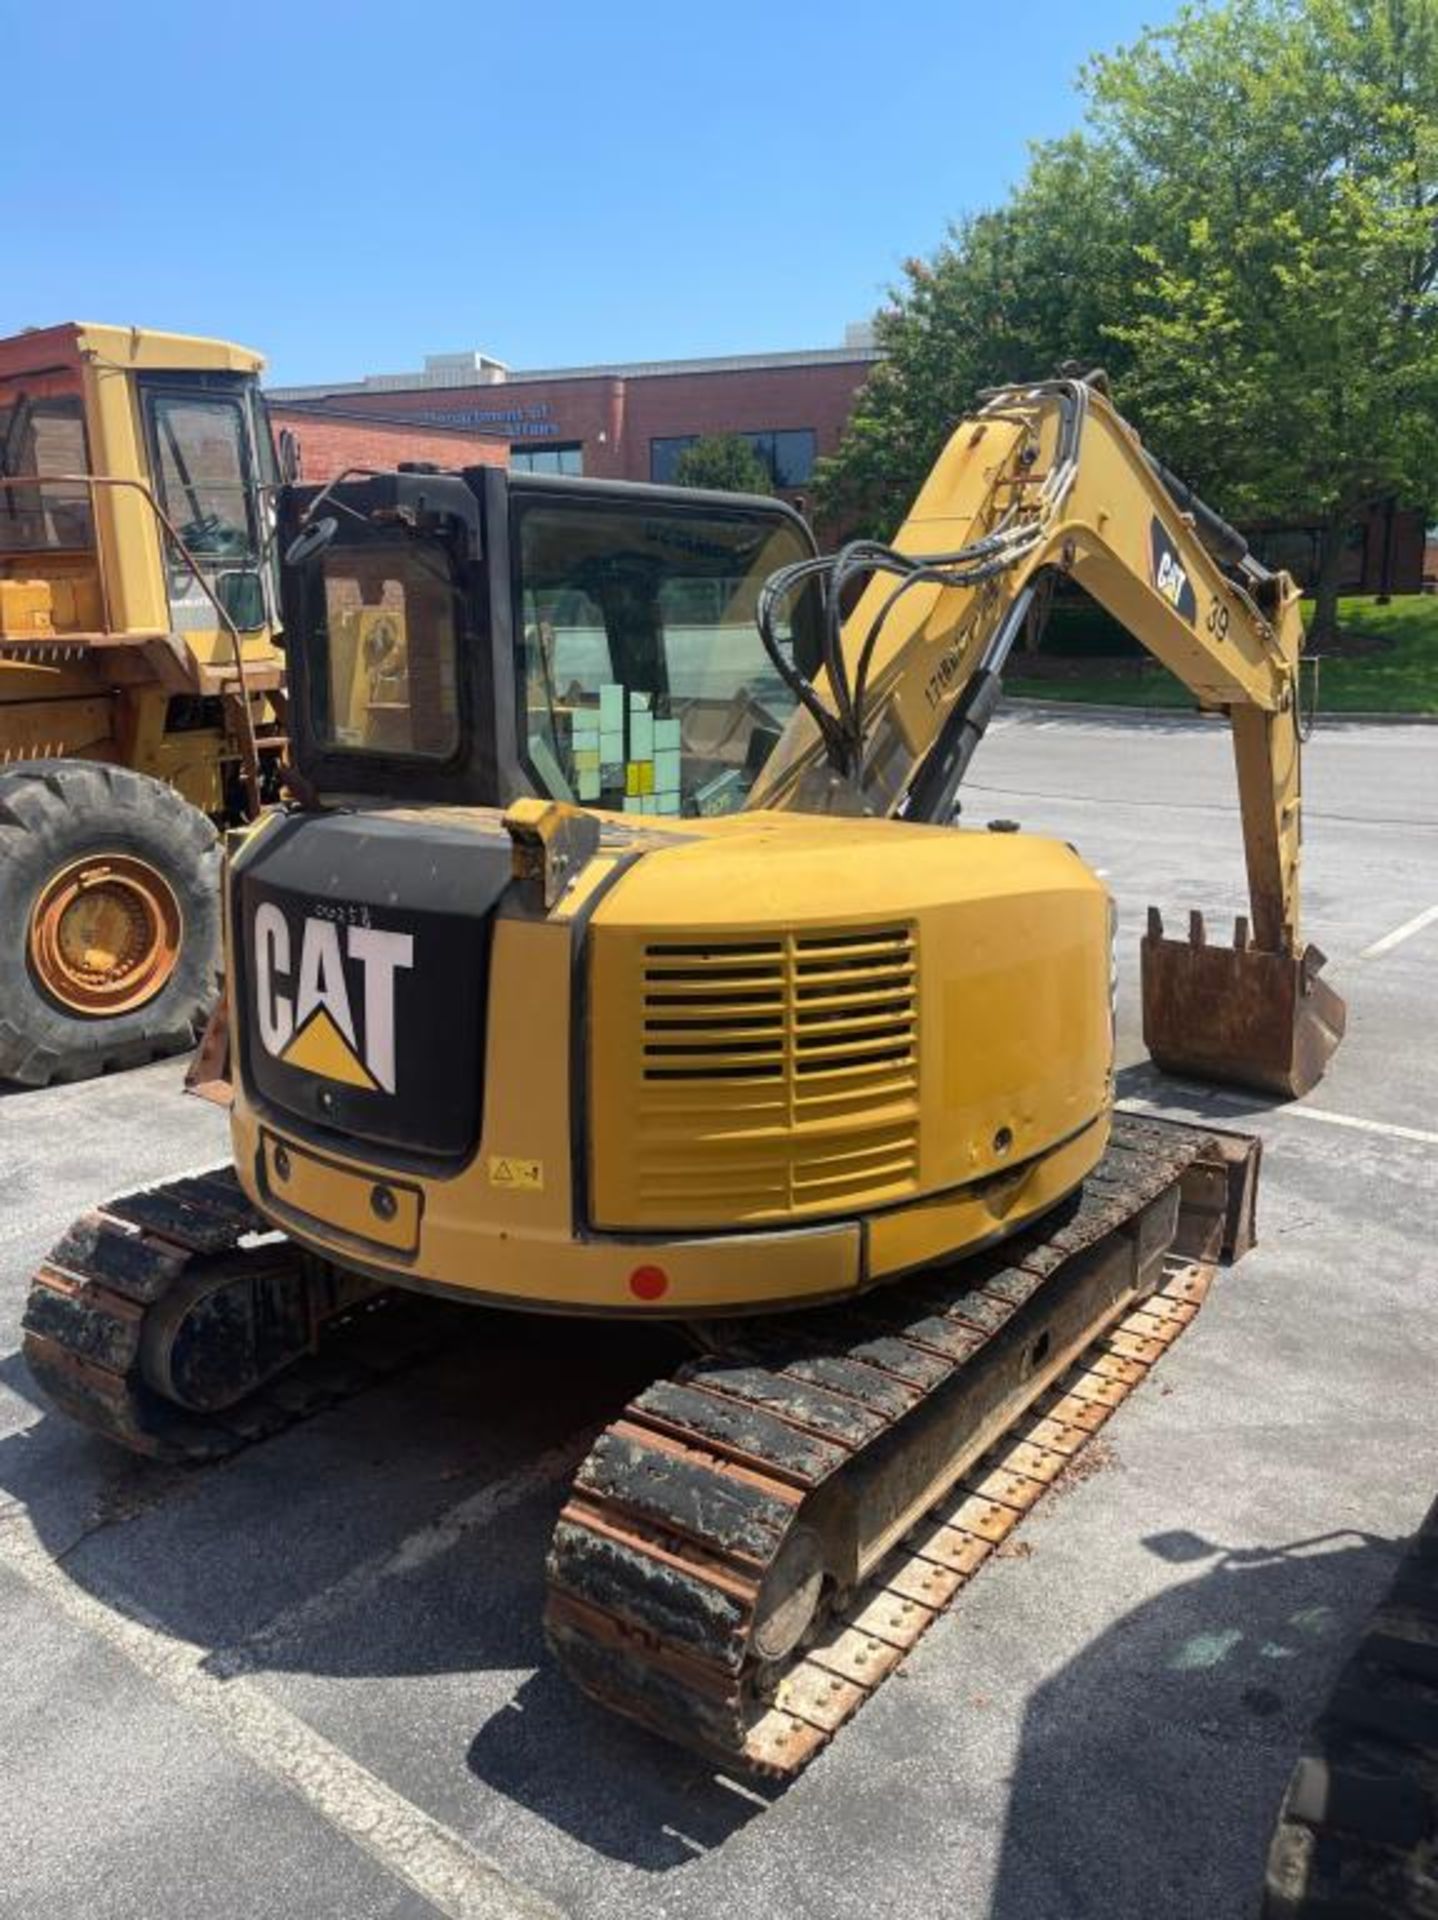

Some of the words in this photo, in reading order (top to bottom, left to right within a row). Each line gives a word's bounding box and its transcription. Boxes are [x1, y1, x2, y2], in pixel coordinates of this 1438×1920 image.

[1157, 551, 1186, 607] CAT
[1206, 596, 1229, 642] 39
[254, 901, 414, 1095] CAT
